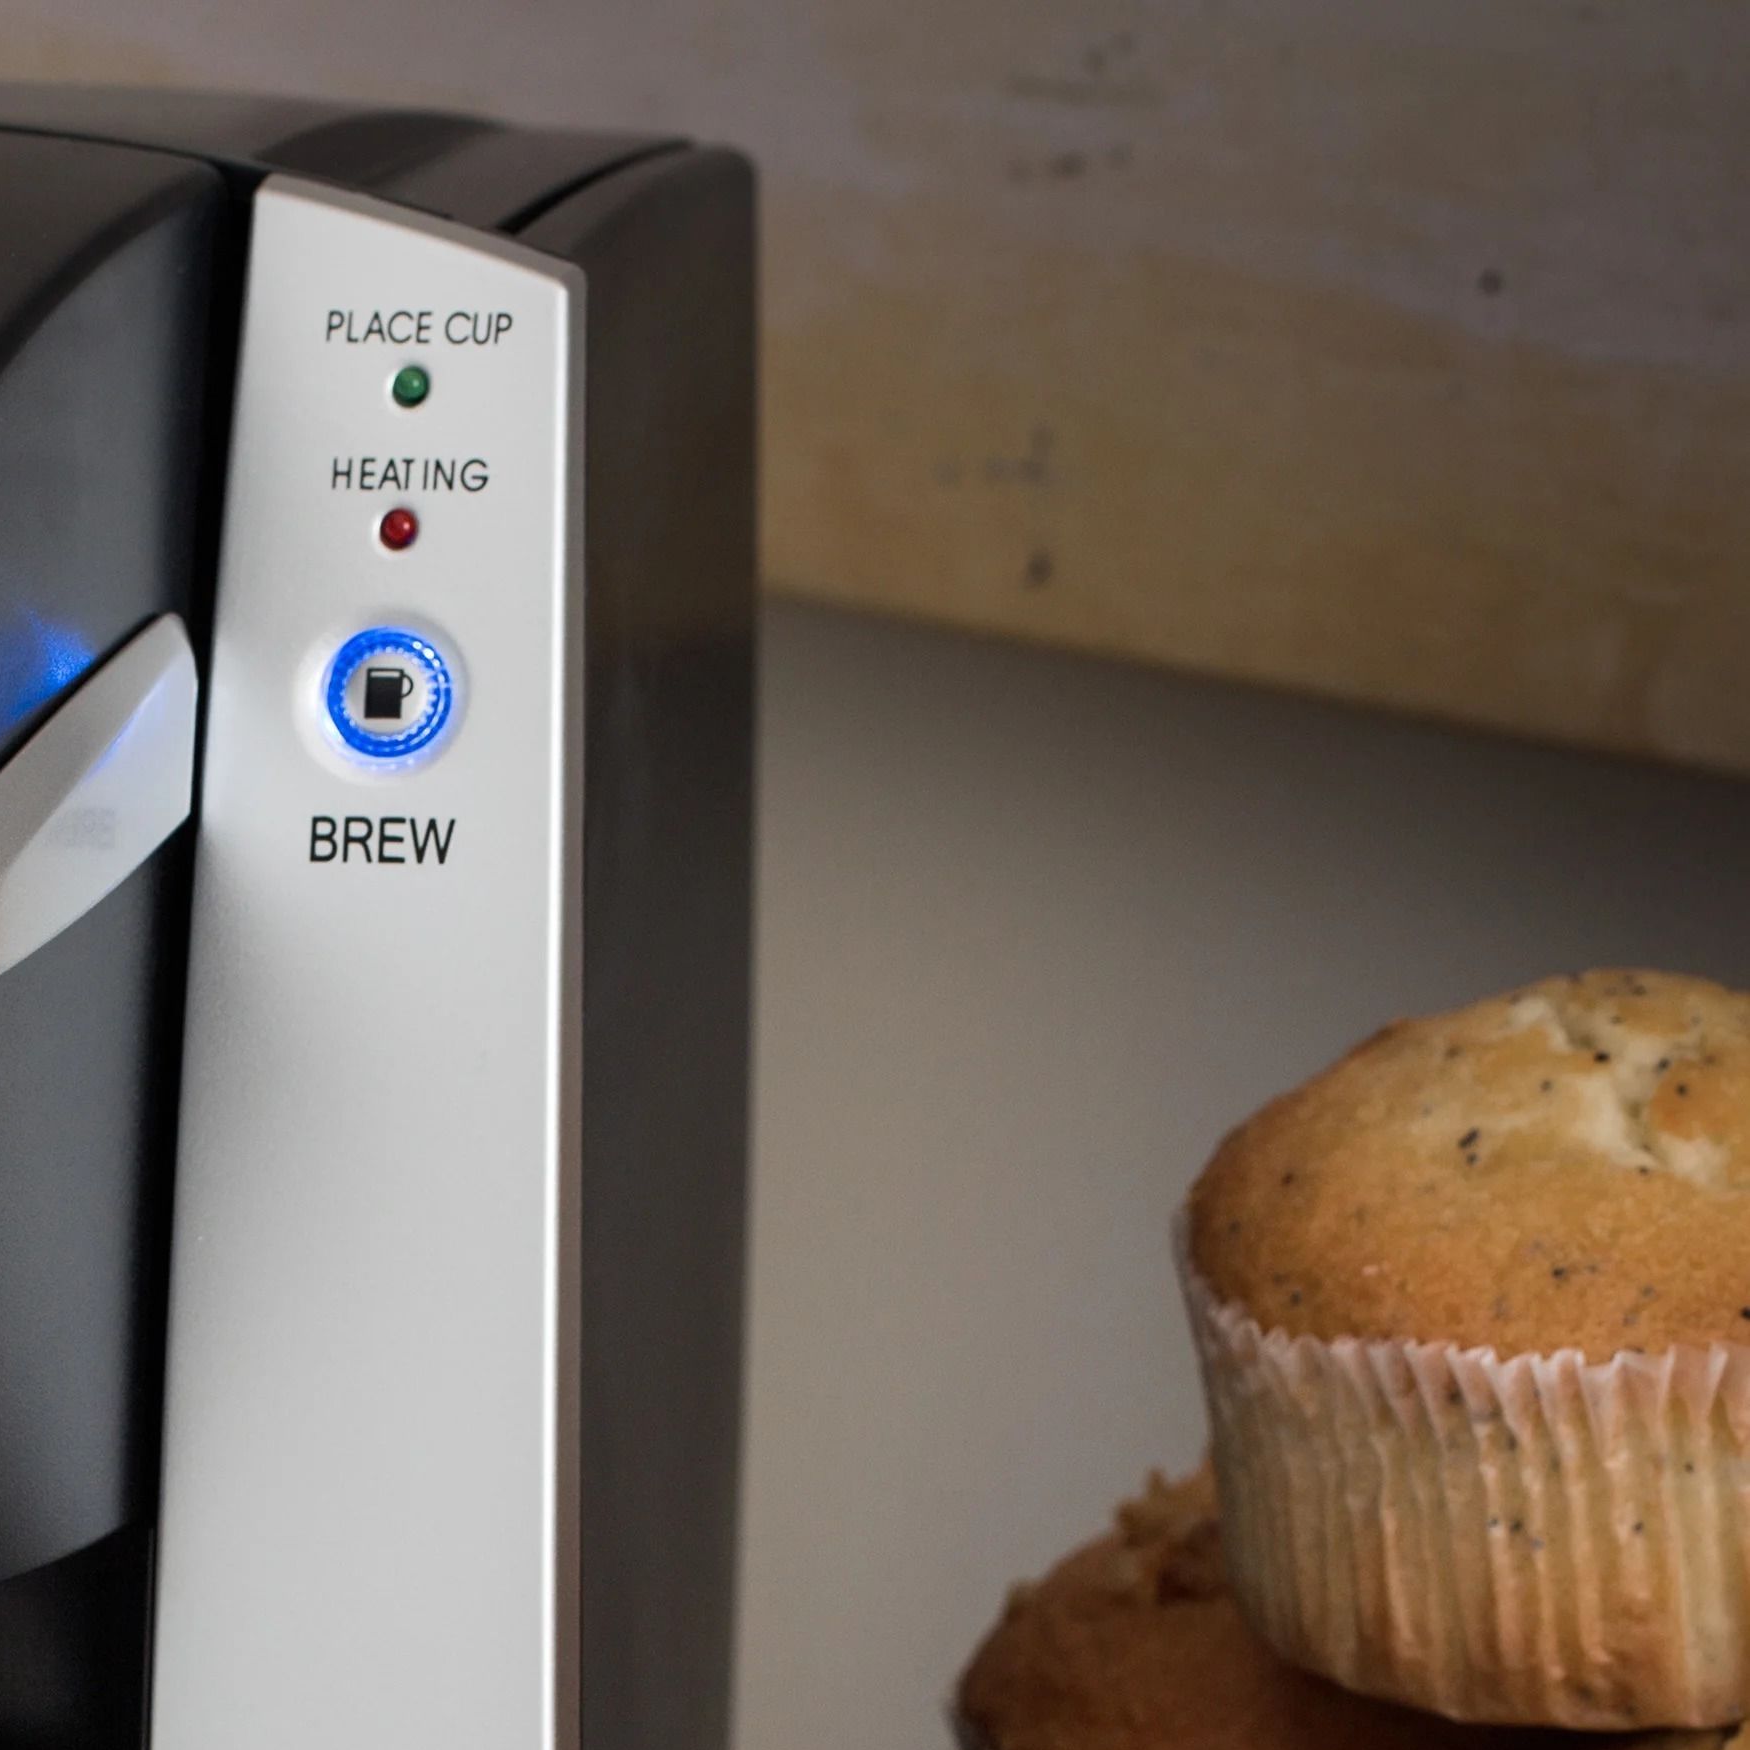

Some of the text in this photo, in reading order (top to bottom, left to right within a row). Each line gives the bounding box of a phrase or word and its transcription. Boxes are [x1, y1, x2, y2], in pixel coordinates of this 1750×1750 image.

[325, 309, 514, 346] PLACE CUP
[330, 456, 490, 493] HEATING
[308, 815, 457, 866] BREW
